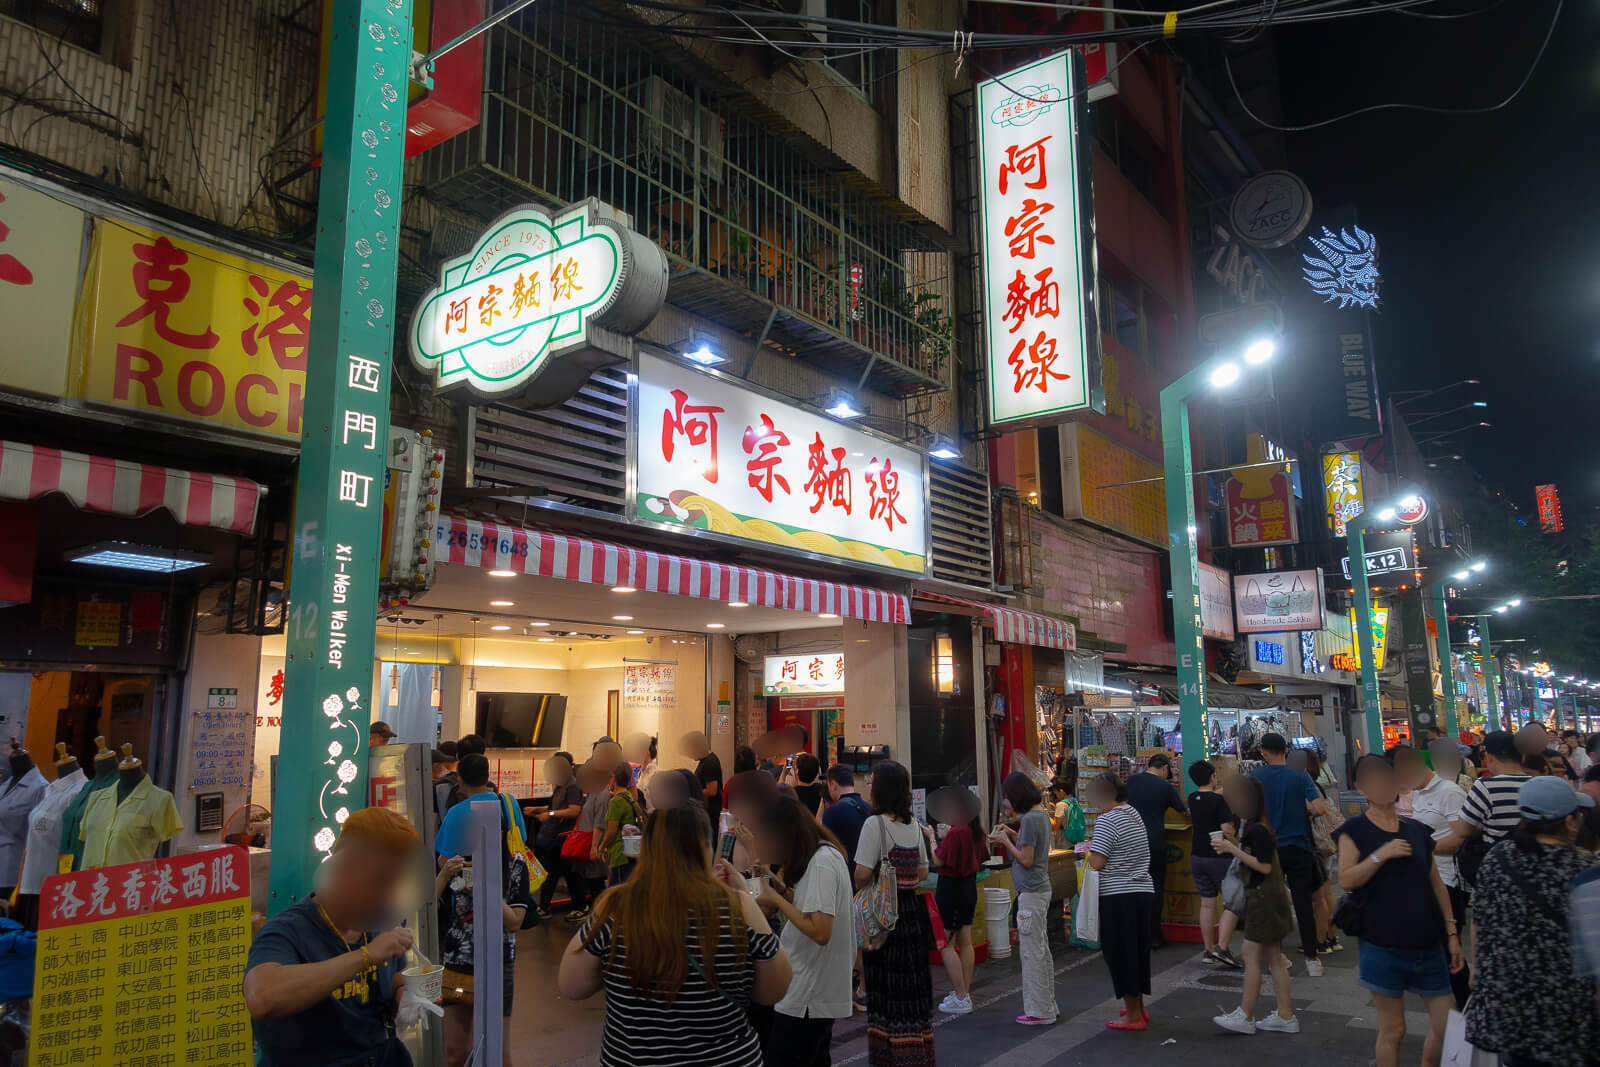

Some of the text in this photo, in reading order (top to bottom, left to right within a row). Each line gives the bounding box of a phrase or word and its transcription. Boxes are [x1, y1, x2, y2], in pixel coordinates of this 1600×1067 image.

[1248, 208, 1292, 233] ZACC
[475, 231, 547, 273] SINCE 1975
[999, 135, 1071, 394] 阿宗麵線
[445, 257, 584, 335] 阿宗麵線
[1339, 332, 1372, 420] BLUE WAY
[339, 354, 381, 508] 西門町
[661, 388, 907, 532] 阿宗麵線
[1233, 500, 1259, 543] 火鍋
[1259, 499, 1286, 541] 酸菜
[301, 520, 319, 559] E
[328, 543, 353, 670] Xi-Men Walker
[292, 602, 319, 640] 12
[1180, 654, 1193, 668] E
[1180, 682, 1198, 696] 14
[196, 750, 218, 759] 09:00
[51, 854, 241, 920] 洛克香港西服
[118, 917, 179, 939] 中山女高
[186, 905, 246, 929] 建國中學
[118, 936, 178, 958] 北商學院
[186, 925, 247, 946] 板橋高中
[43, 948, 107, 971] 師大附中
[117, 955, 178, 978] 東山高中
[186, 943, 246, 967] 延平高中
[116, 973, 177, 997] 大安高工
[186, 963, 246, 985] 新店高中
[40, 987, 105, 1010] 康橋高中
[115, 993, 177, 1017] 開平高中
[186, 1002, 247, 1025] 北一女中
[113, 1032, 176, 1056] 成功高中
[186, 1021, 246, 1044] 松山高中
[185, 1040, 246, 1064] 華江高中
